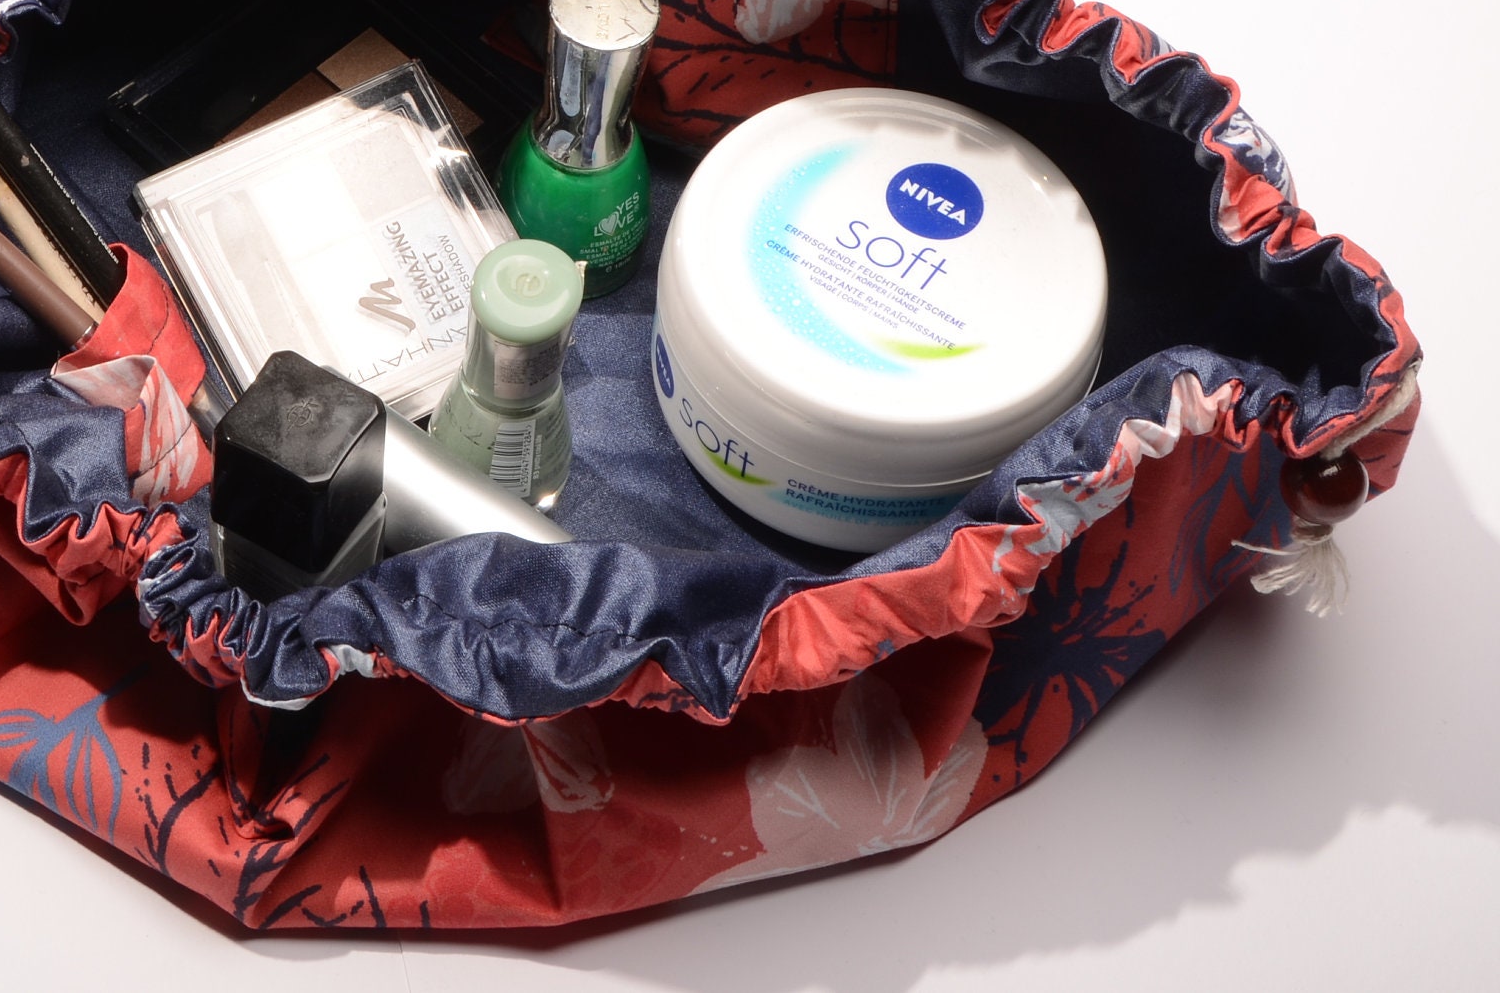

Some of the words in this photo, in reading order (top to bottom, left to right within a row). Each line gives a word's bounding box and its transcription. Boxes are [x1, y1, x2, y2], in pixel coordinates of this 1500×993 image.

[616, 191, 640, 214] YES
[899, 178, 966, 225] NIVEA
[386, 220, 447, 321] EYEMAZING
[422, 252, 465, 314] EFFECT
[765, 238, 802, 263] CRÈME
[800, 258, 865, 300] HYDRATANTE
[783, 223, 858, 268] ERFRISCHENDE
[856, 262, 967, 330] FEUCHTIGKEITSCREME
[817, 253, 853, 279] GESICHT
[855, 273, 889, 297] KÖRPER
[891, 292, 921, 315] HÄNDE
[808, 274, 839, 295] VISAGE
[841, 291, 869, 313] CORPS
[872, 309, 900, 330] MAINS
[787, 477, 841, 502] CRÈME
[843, 494, 946, 509] HYDRATANTE
